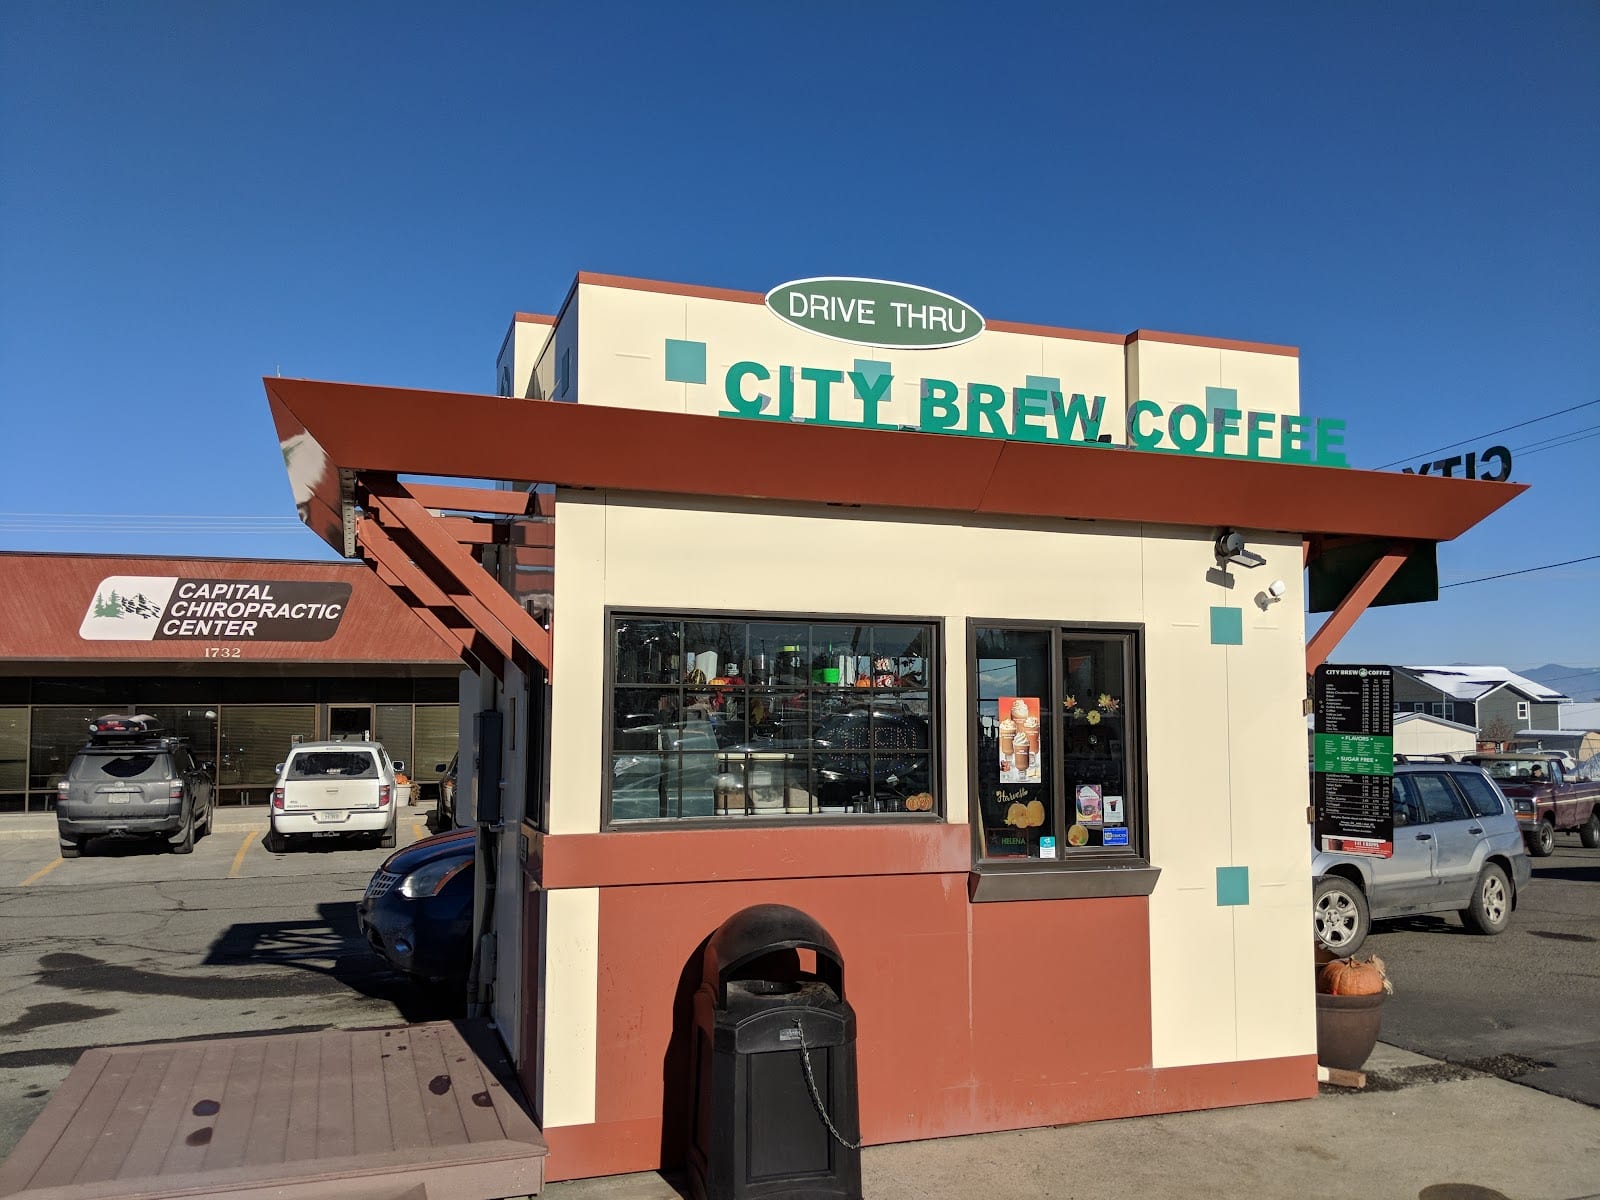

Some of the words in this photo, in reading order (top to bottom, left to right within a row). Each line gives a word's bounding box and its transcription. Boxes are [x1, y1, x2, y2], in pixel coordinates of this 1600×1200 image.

[789, 291, 876, 325] DRIVE
[890, 302, 966, 333] THRU
[724, 360, 896, 426] CITY
[919, 377, 1107, 442] BREW
[1126, 399, 1347, 466] COFFEE
[178, 582, 274, 600] CAPITAL
[170, 601, 342, 620] CHIROPRACTIC
[162, 620, 258, 636] CENTER
[204, 648, 241, 658] 1732
[1001, 837, 1026, 845] HELENA
